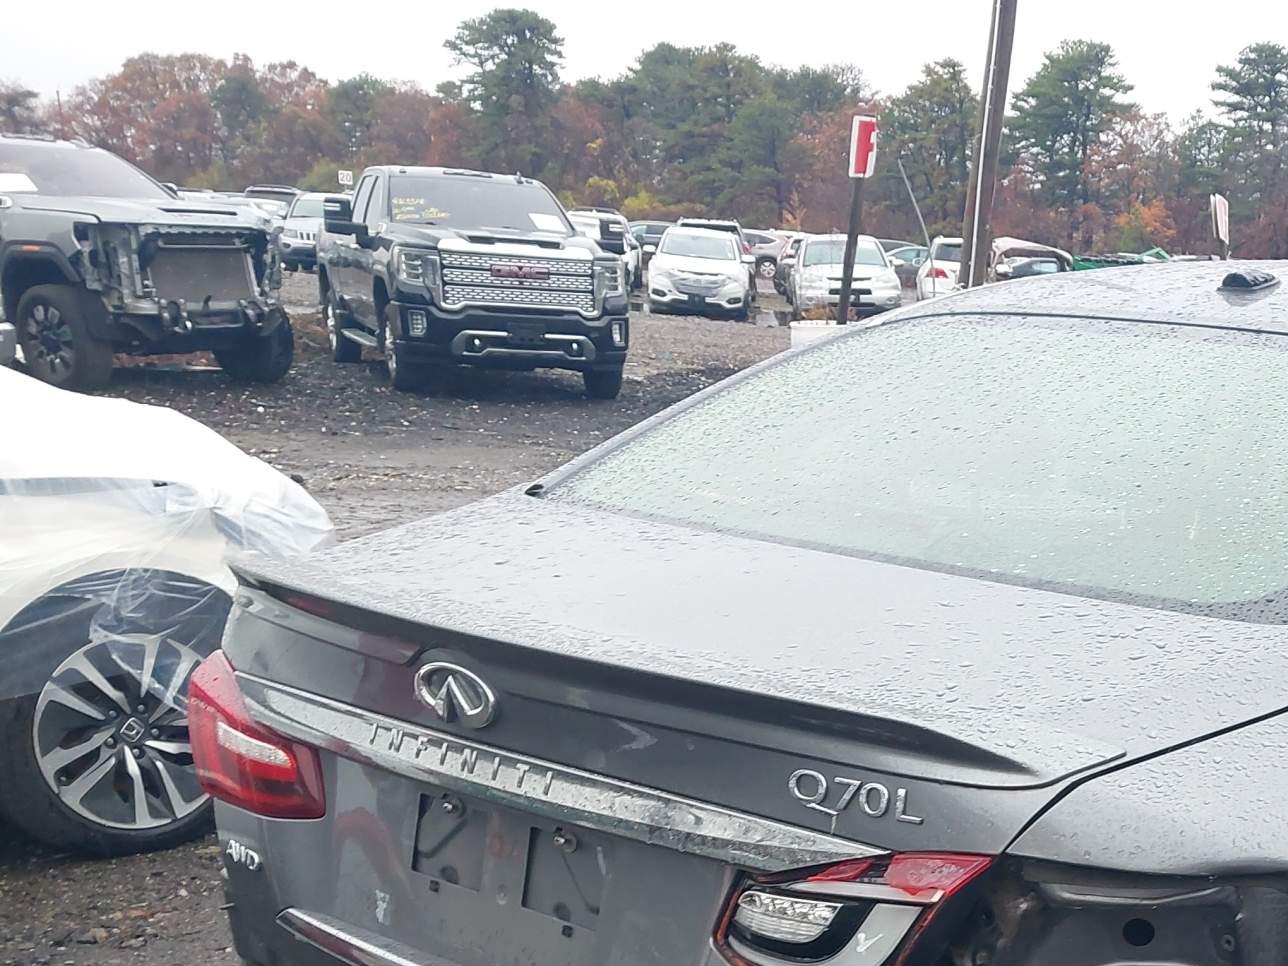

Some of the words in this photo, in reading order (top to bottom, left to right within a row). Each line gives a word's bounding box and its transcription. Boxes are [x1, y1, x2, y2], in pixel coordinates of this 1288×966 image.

[339, 172, 352, 183] 20
[491, 264, 550, 281] GMC
[368, 721, 554, 797] INFINITI
[788, 768, 924, 824] Q70L
[225, 839, 260, 870] AWD
